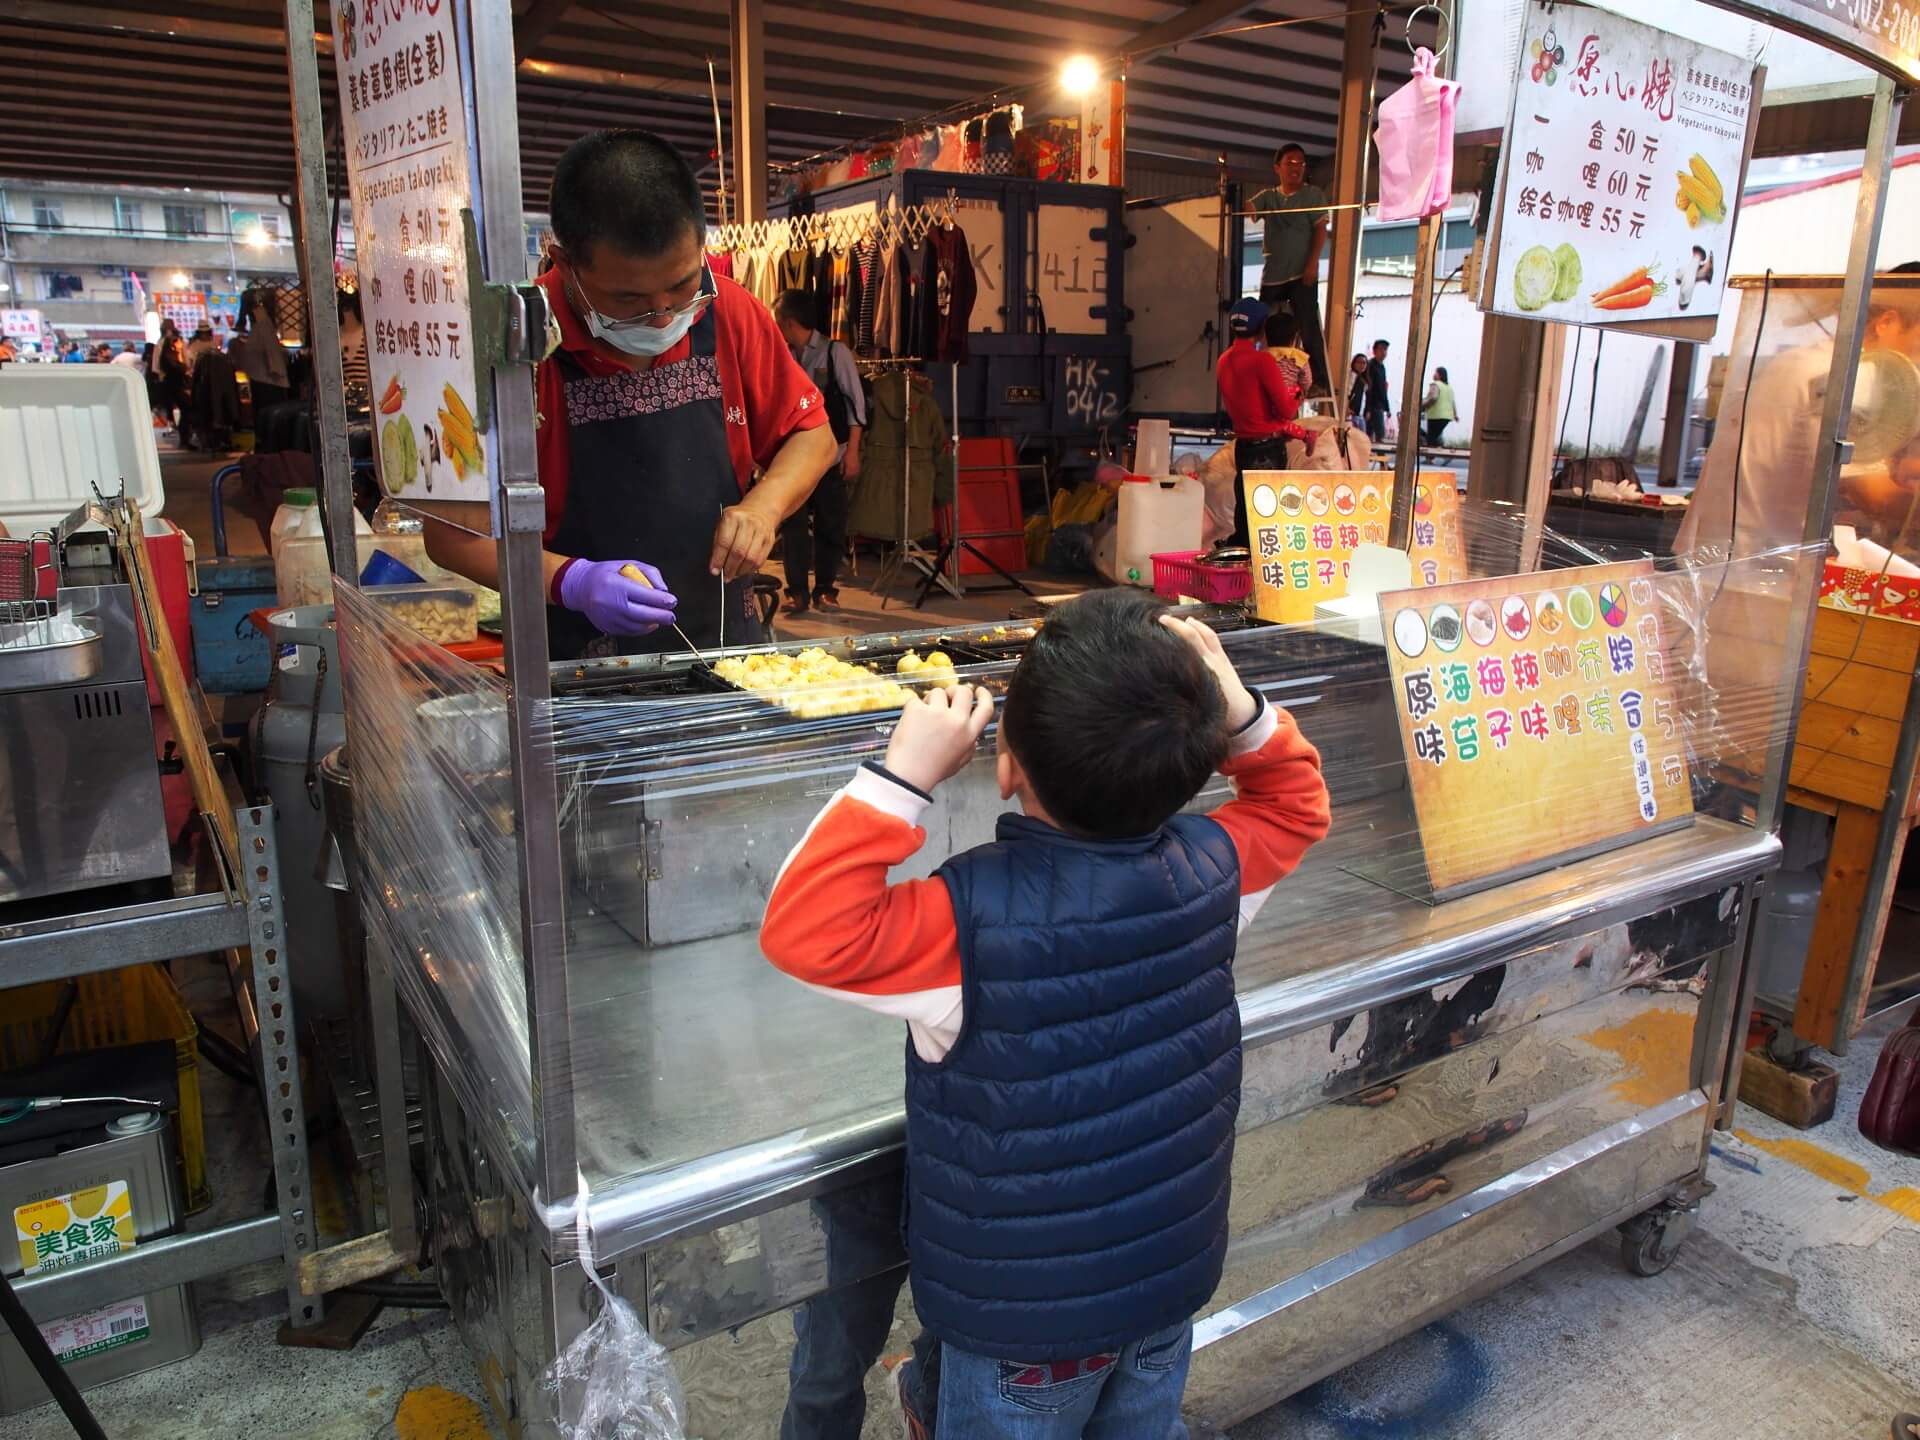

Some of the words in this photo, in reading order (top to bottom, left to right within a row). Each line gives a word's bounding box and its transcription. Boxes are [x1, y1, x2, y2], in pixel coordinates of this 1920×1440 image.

[1677, 114, 1712, 132] Vegetarian
[1714, 125, 1742, 141] takoyaki
[357, 172, 405, 208] Vegetarian
[408, 156, 455, 192] takoyaki
[1517, 186, 1594, 228] 綜合咖哩
[35, 1216, 119, 1259] 美食家
[40, 1240, 121, 1272] 油炸專用油
